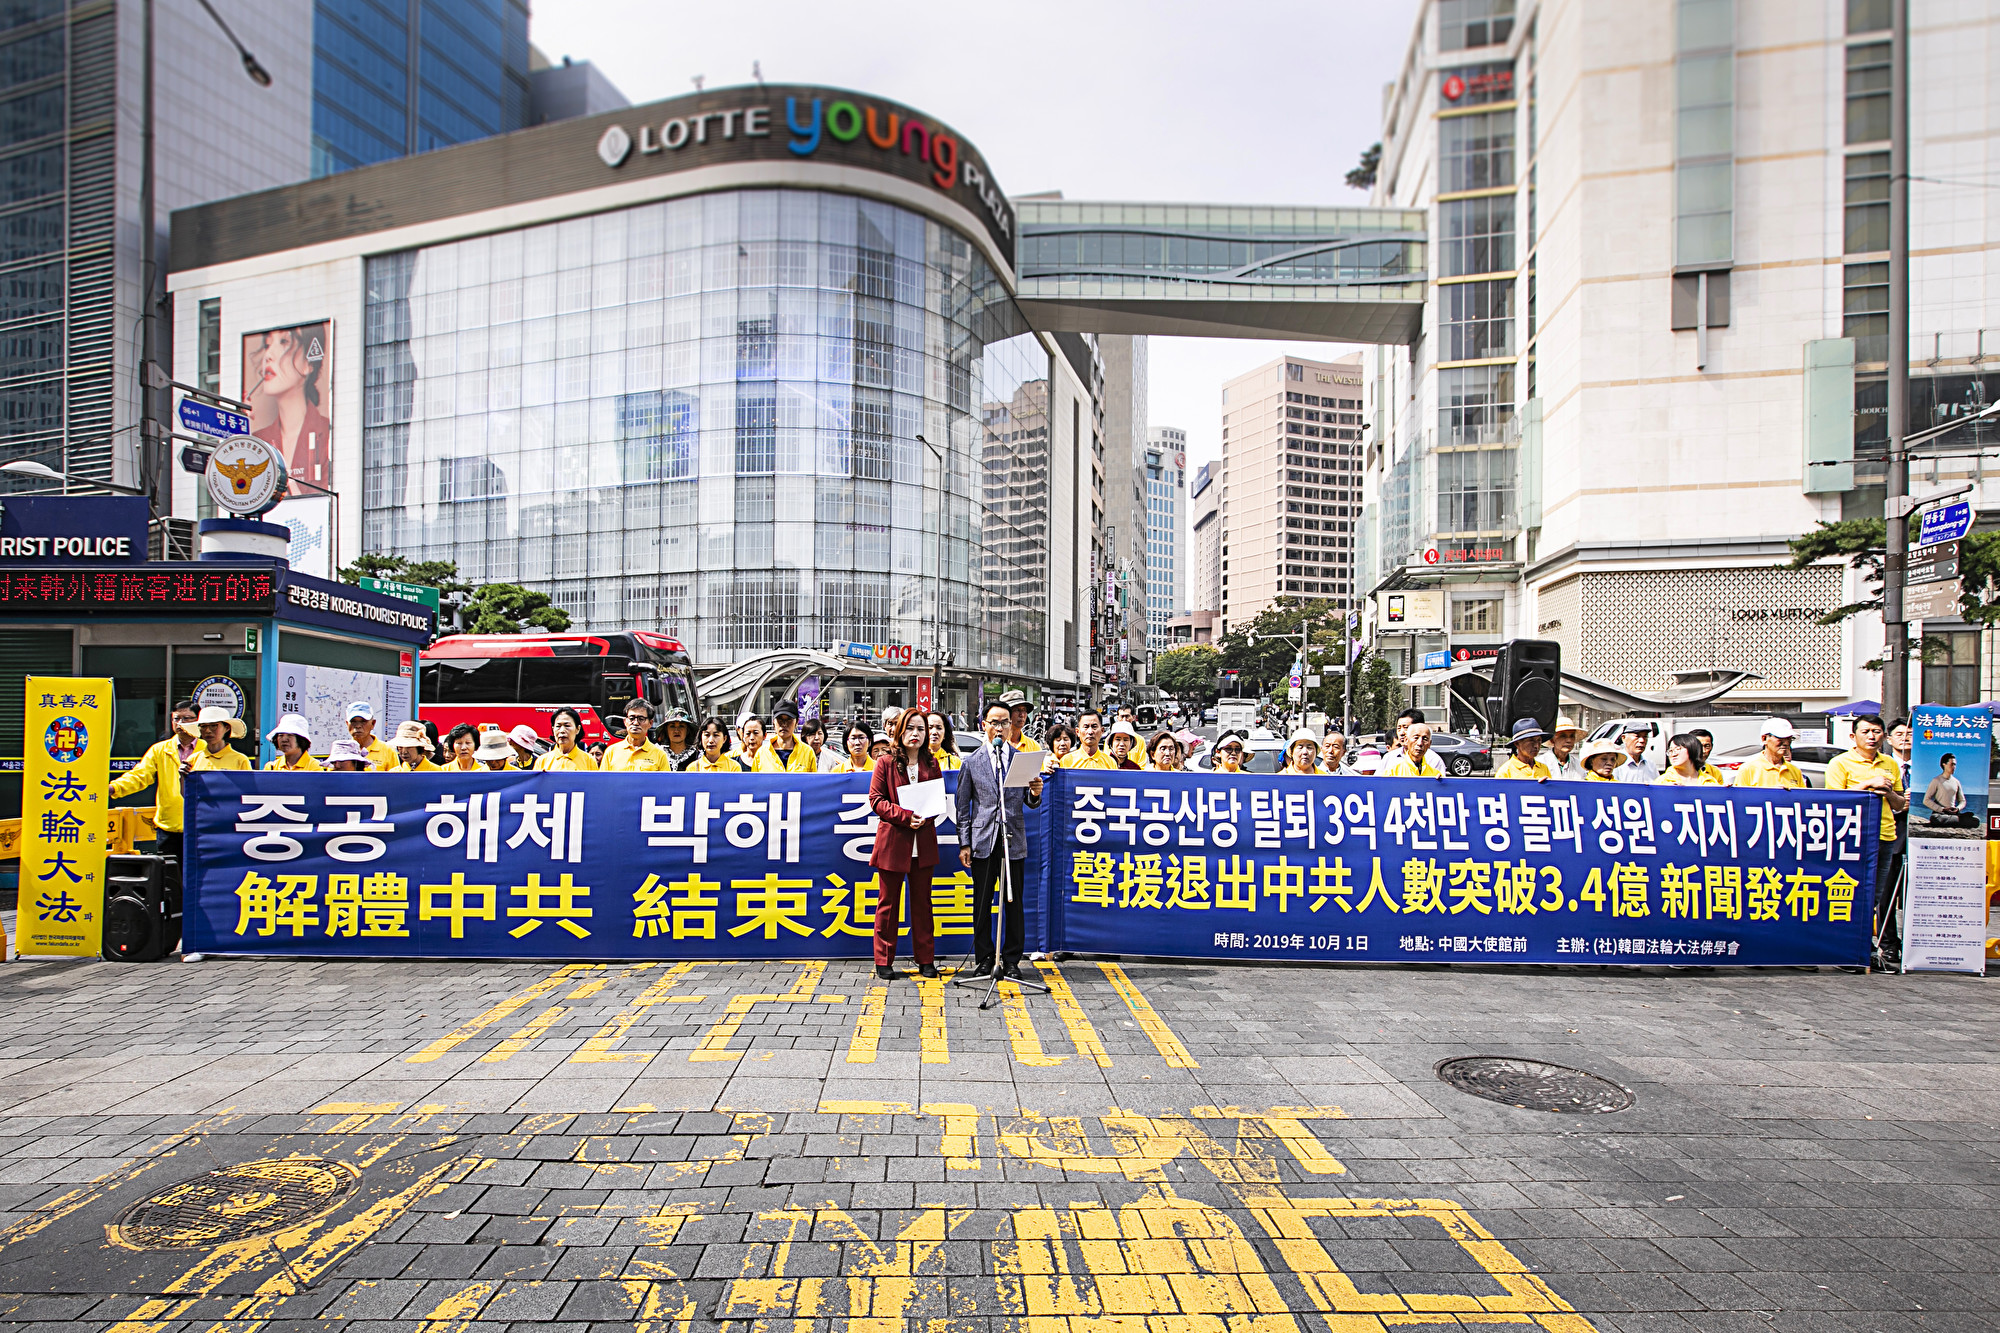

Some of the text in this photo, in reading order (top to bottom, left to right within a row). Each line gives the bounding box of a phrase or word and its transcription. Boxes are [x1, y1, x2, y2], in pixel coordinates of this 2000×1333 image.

[639, 108, 770, 154] LOTTE
[786, 97, 957, 189] young
[1315, 371, 1332, 384] THE
[216, 411, 247, 433] 명동길
[217, 487, 249, 506] METROPOLITAN
[249, 491, 265, 505] POLICE
[263, 471, 271, 493] AGENCY
[1923, 517, 1967, 535] Myeongdong-gil
[1924, 508, 1946, 525] 명동길
[0, 537, 131, 556] RIST POLICE
[1444, 547, 1504, 562] 롯데시네마
[383, 582, 402, 592] 서울역
[287, 584, 428, 631] 관광경찰 KOREA TOURIST POLICE
[1732, 607, 1826, 619] LOUIS VUITTON
[872, 645, 911, 666] ung
[38, 693, 98, 710] 真善忍
[1916, 713, 1990, 729] 法輪大法
[235, 794, 395, 863] 중공
[425, 791, 585, 864] 해체
[640, 791, 802, 863] 박해
[1071, 785, 1241, 848] 중국공산당
[1250, 789, 1316, 850] 탈퇴
[1324, 790, 1377, 851] 3억
[1384, 791, 1471, 851] 4천만
[1477, 792, 1511, 853] 명
[1518, 794, 1584, 854] 돌파
[1746, 800, 1862, 862] 기자회견
[35, 770, 87, 923] 法輪大法
[234, 871, 593, 939] 解體中共
[1214, 932, 1369, 951] 時間: 2019年 10月 1日
[1399, 935, 1527, 953] 地點: 中國大使館前
[1556, 937, 1740, 956] 主辦: (社)韓國法輪大法佛學會
